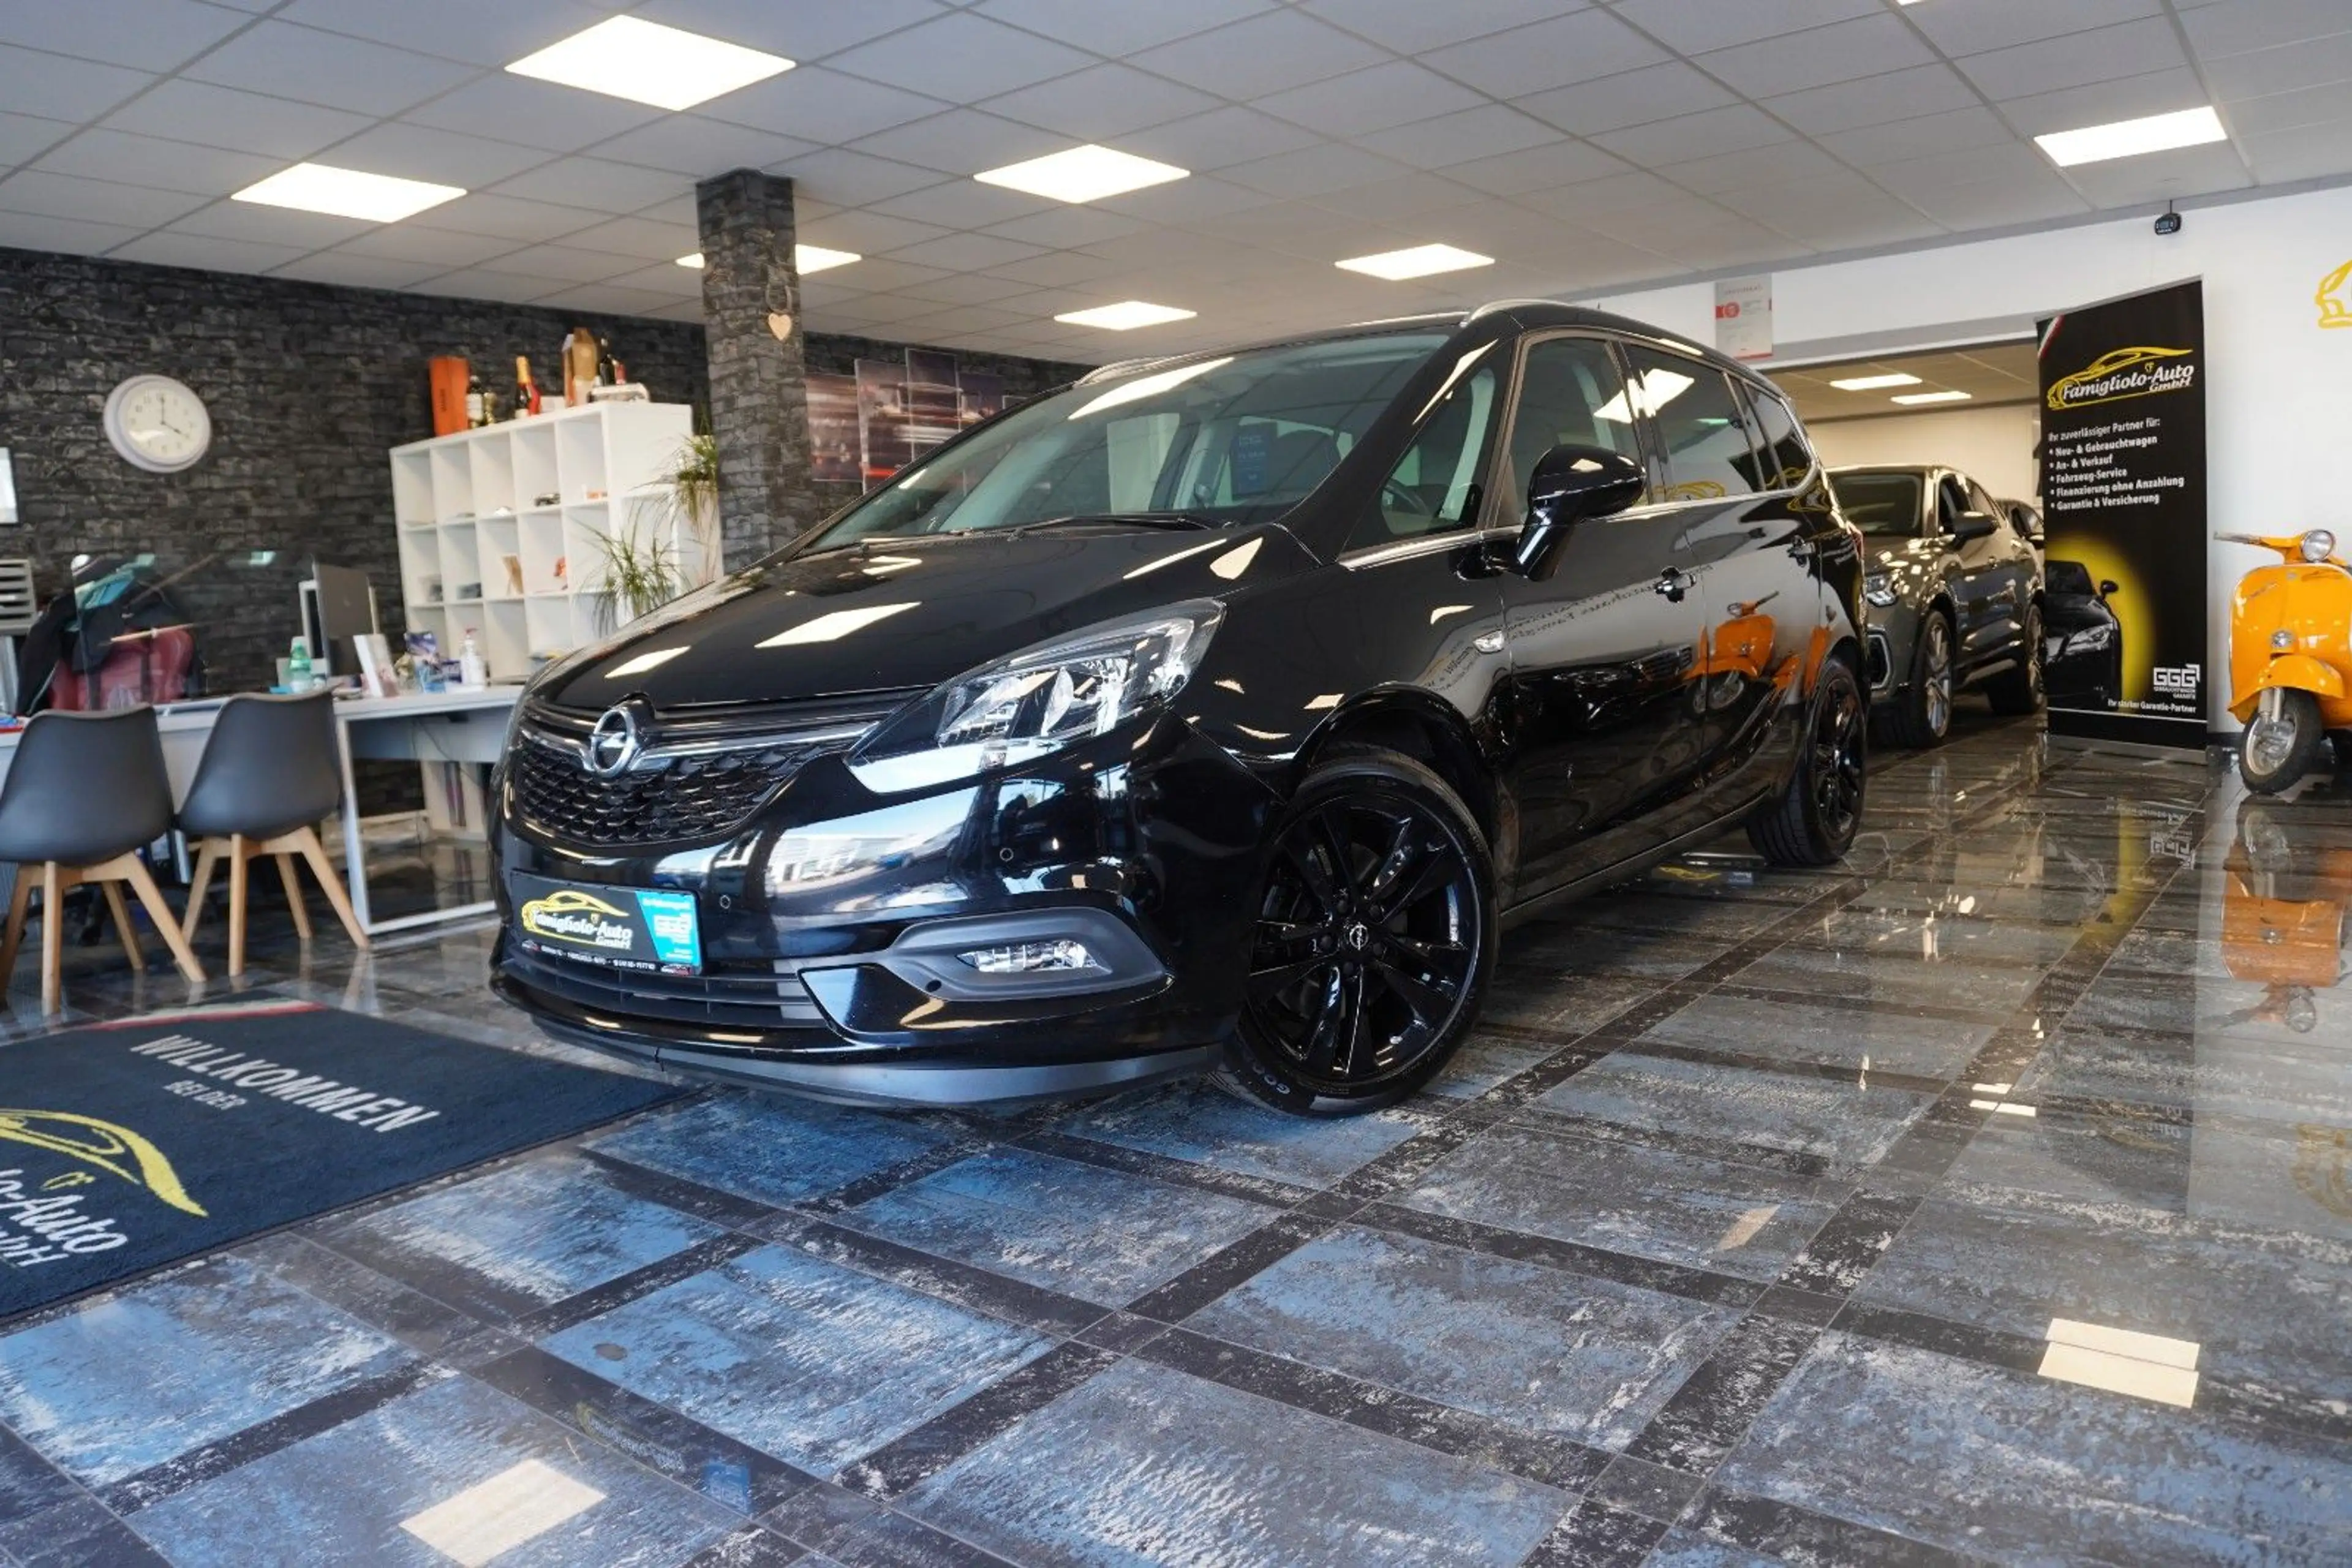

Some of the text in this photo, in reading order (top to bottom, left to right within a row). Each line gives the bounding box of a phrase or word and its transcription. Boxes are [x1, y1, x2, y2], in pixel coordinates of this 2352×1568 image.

[2063, 364, 2195, 400] Famigliolo-Auto
[2149, 377, 2192, 391] GmbH
[2112, 423, 2144, 433] Partner
[2085, 436, 2157, 453] Gebrauchtwagen
[2080, 453, 2113, 467] Verkauf
[2056, 476, 2185, 497] Finanzierung ohne Anzahlung
[2056, 498, 2093, 511] Garantie
[2101, 494, 2160, 507] Versicherung
[2140, 701, 2196, 713] Garantie-Partner
[129, 1034, 440, 1133] WILLKOMMEN
[162, 1079, 248, 1110] BEI DER
